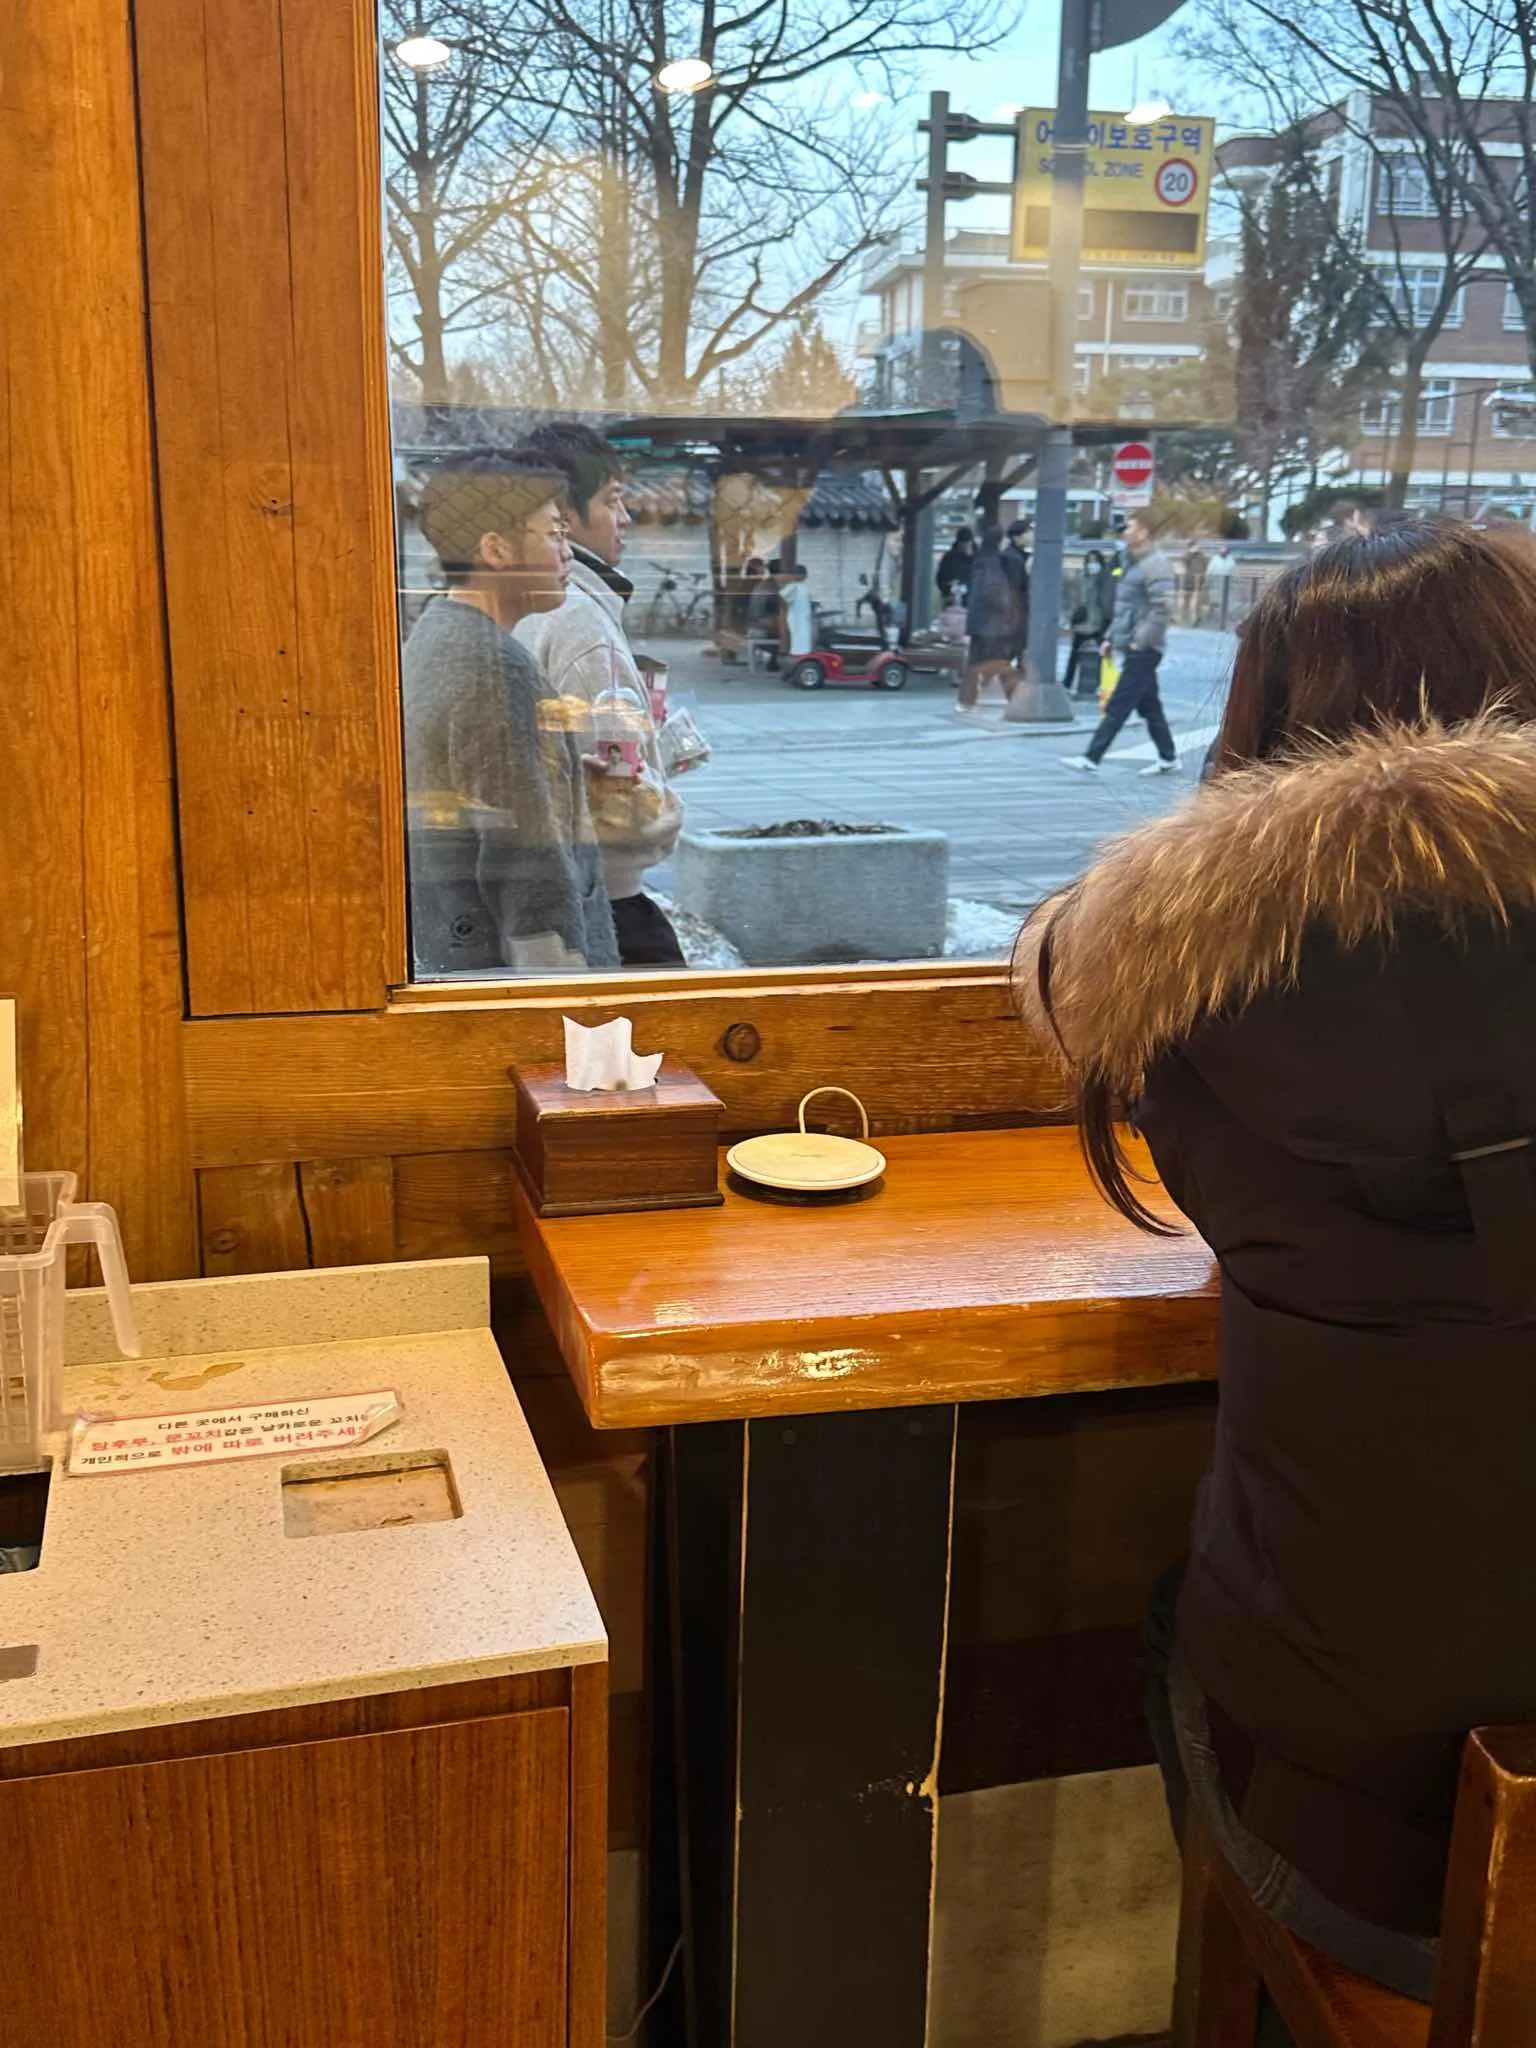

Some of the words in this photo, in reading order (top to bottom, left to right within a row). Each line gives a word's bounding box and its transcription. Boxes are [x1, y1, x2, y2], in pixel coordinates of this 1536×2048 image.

[1036, 120, 1201, 153] 어이보호구역
[1104, 161, 1144, 178] ZONE
[1164, 173, 1188, 192] 20
[158, 1420, 189, 1430] 다른
[196, 1415, 242, 1427] 곳에서
[248, 1407, 310, 1420] 구매하신
[260, 1419, 323, 1432] 날카로운
[80, 1450, 162, 1465] 개인적으로
[171, 1442, 213, 1456] 밖에
[222, 1436, 265, 1449] 따로
